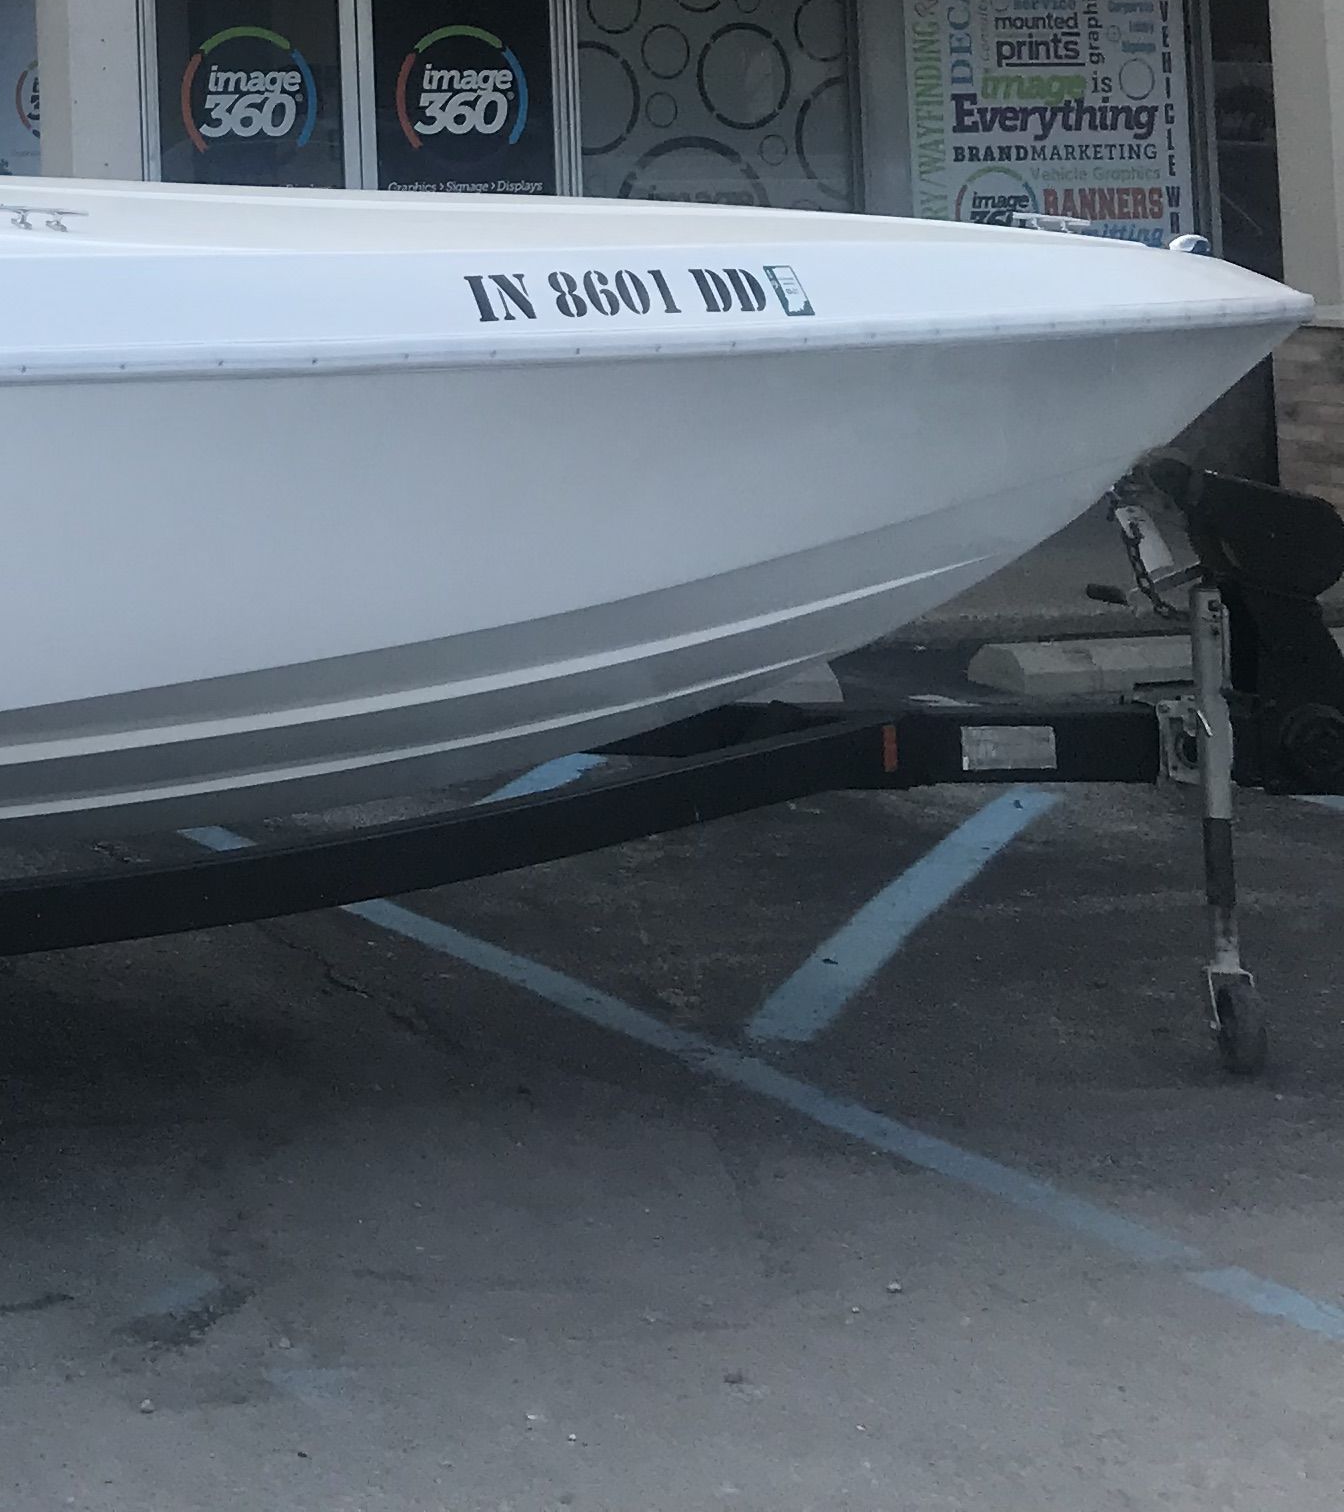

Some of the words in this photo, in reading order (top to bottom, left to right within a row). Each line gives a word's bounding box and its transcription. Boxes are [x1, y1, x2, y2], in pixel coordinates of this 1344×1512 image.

[995, 14, 1078, 31] mounted
[996, 32, 1080, 67] prints
[209, 65, 301, 94] image
[423, 64, 512, 94] image
[982, 73, 1086, 105] image
[1091, 72, 1112, 94] is
[951, 94, 1159, 141] Everything
[497, 181, 542, 194] Displays
[1030, 167, 1088, 182] Vehicle
[1092, 166, 1161, 184] Graphics
[972, 190, 1029, 213] image
[1043, 186, 1164, 220] BANNERS
[464, 273, 537, 322] IN
[548, 269, 681, 318] 8601
[688, 268, 767, 313] DD
